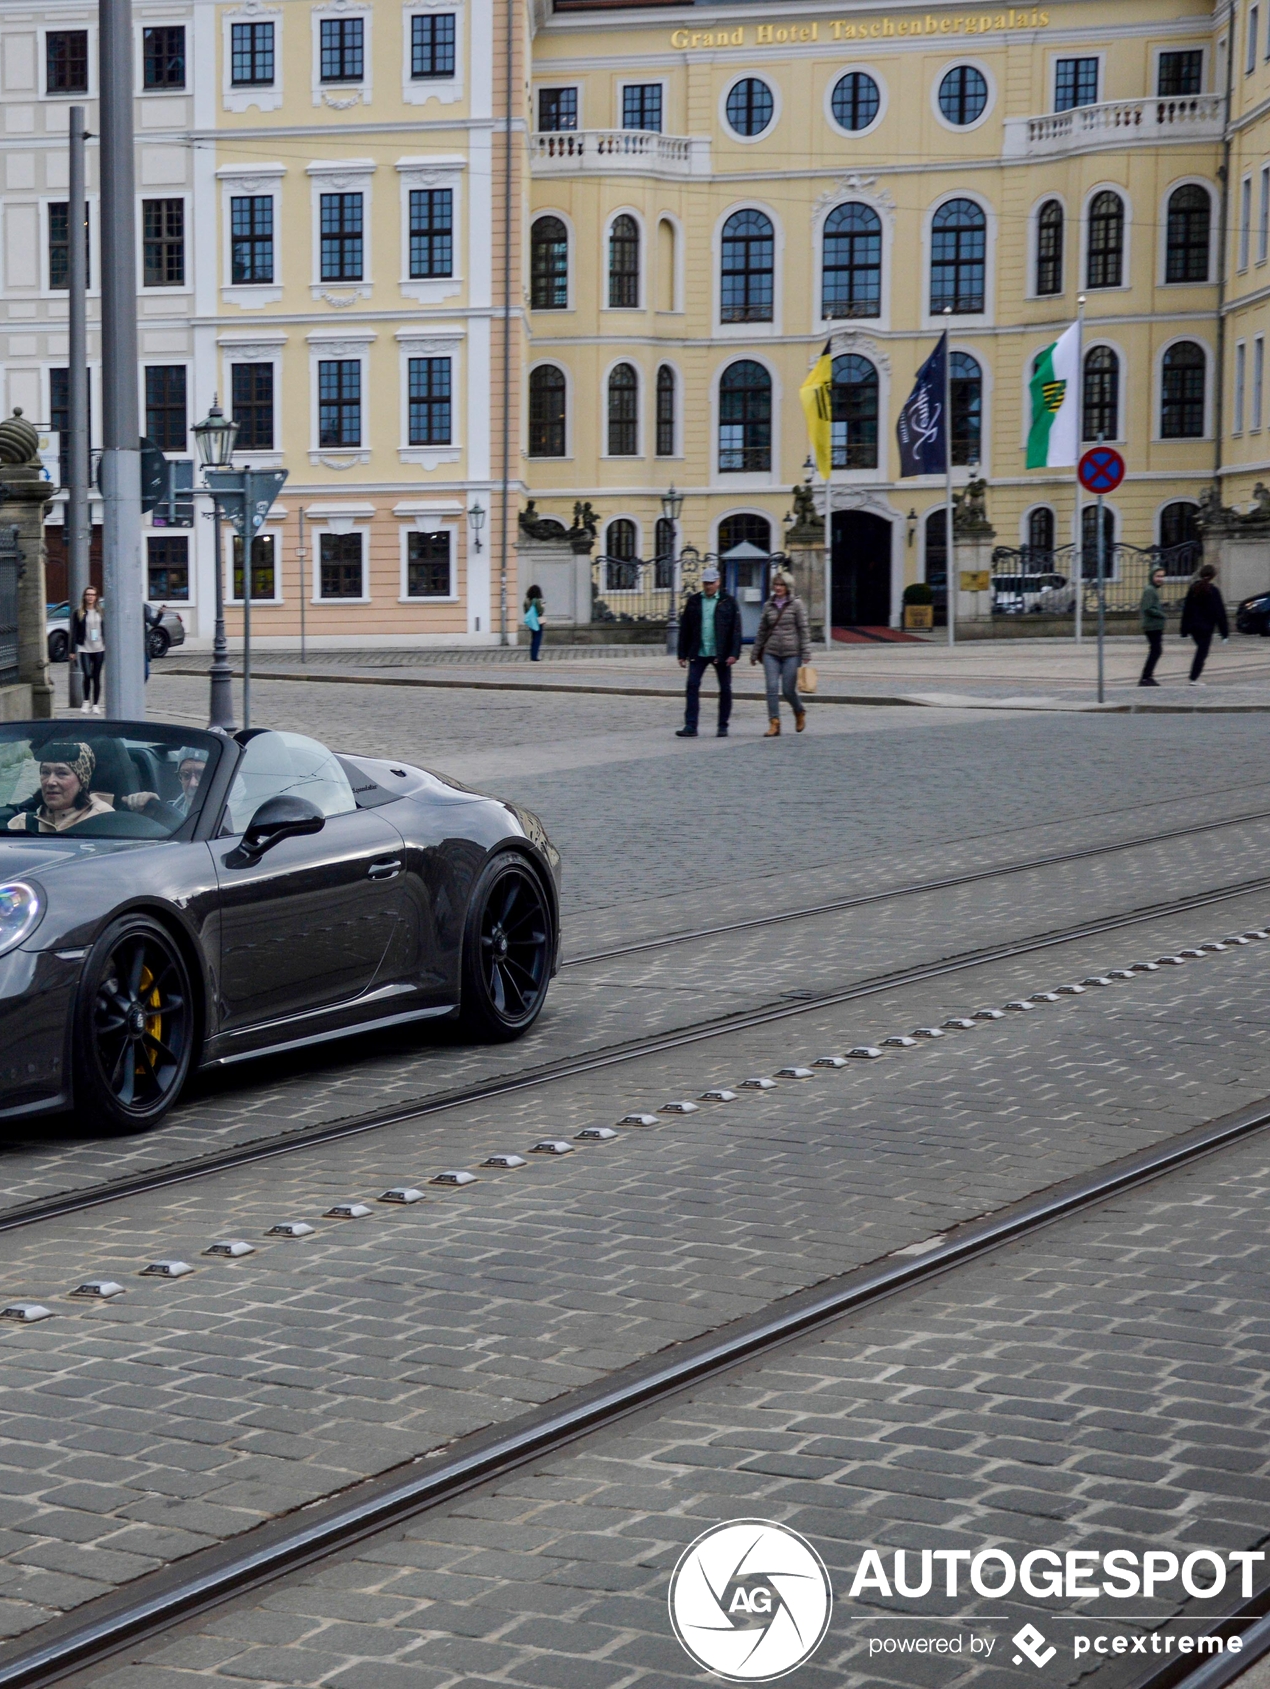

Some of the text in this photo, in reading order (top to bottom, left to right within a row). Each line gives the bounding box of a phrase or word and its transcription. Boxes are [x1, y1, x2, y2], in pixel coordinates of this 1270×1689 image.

[670, 8, 1050, 49] Grand Hotel Taschenbergpalais
